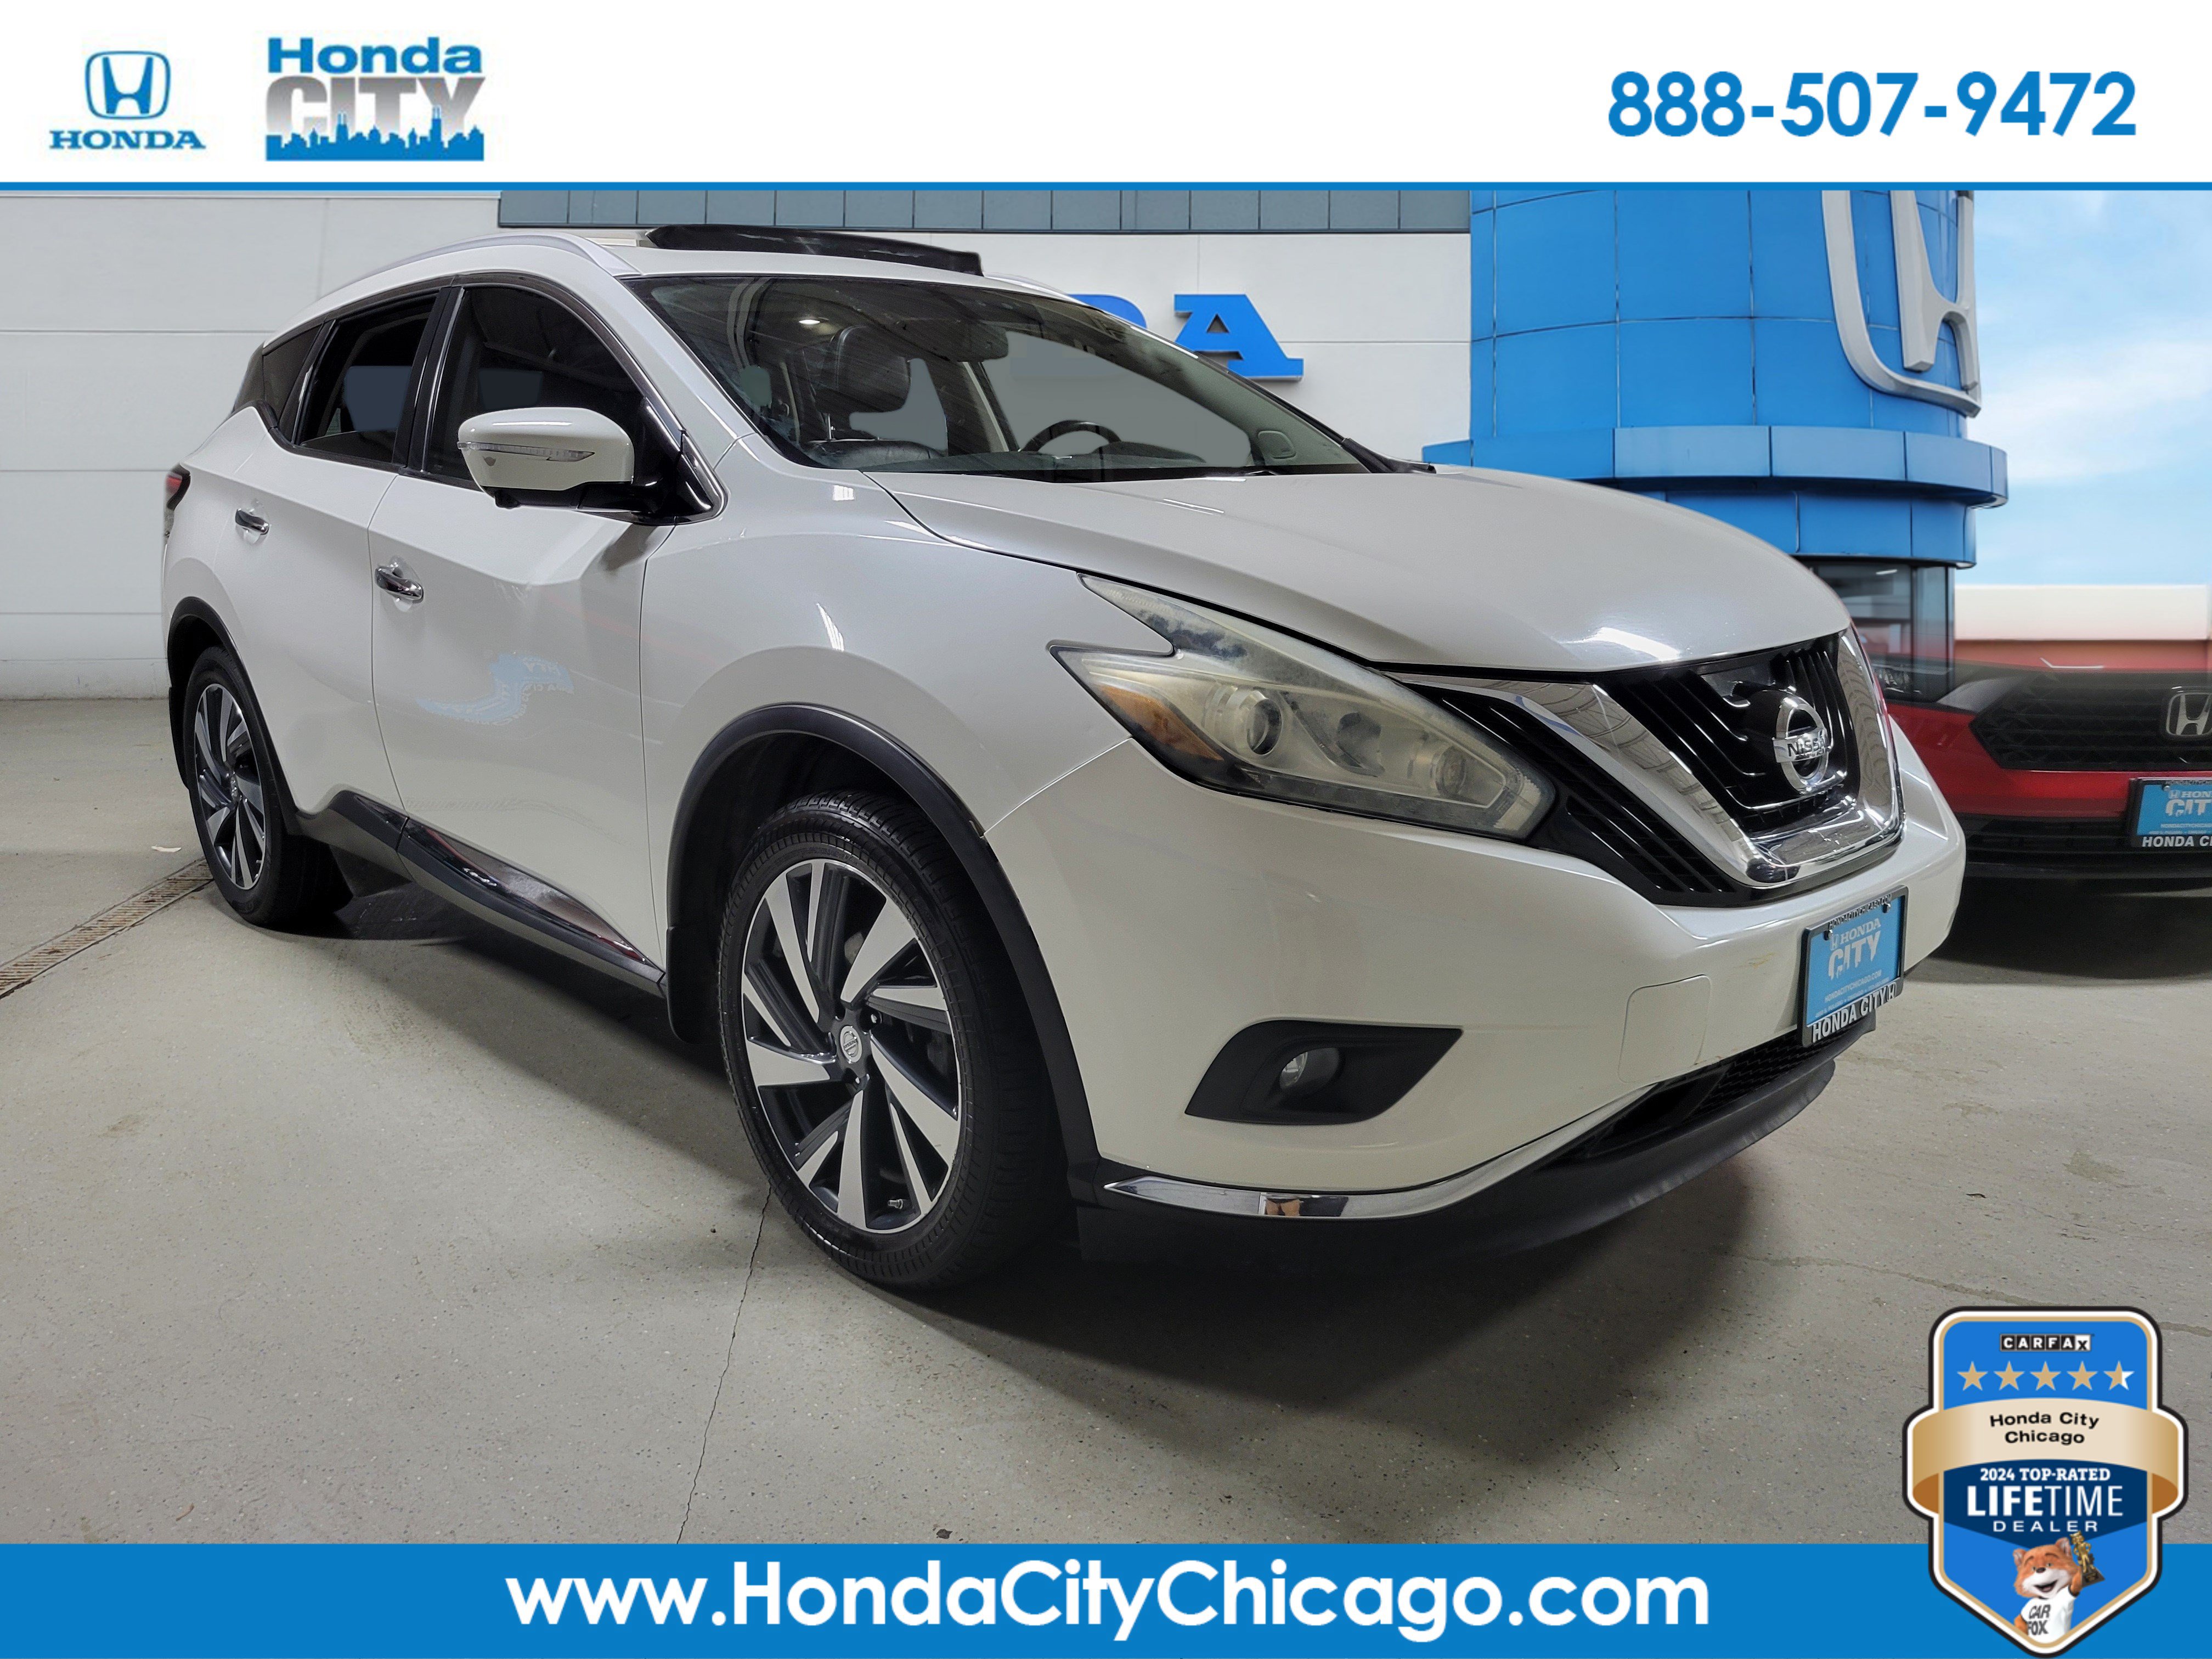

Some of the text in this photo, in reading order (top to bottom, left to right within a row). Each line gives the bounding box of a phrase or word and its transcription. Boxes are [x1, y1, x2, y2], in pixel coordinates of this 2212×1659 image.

[1067, 294, 1304, 379] A
[2141, 836, 2194, 847] HONDA
[1828, 930, 1881, 980] CITY
[1839, 918, 1881, 944] HONDA
[1812, 1003, 1858, 1043] HONDA
[1860, 986, 1887, 1016] CITY
